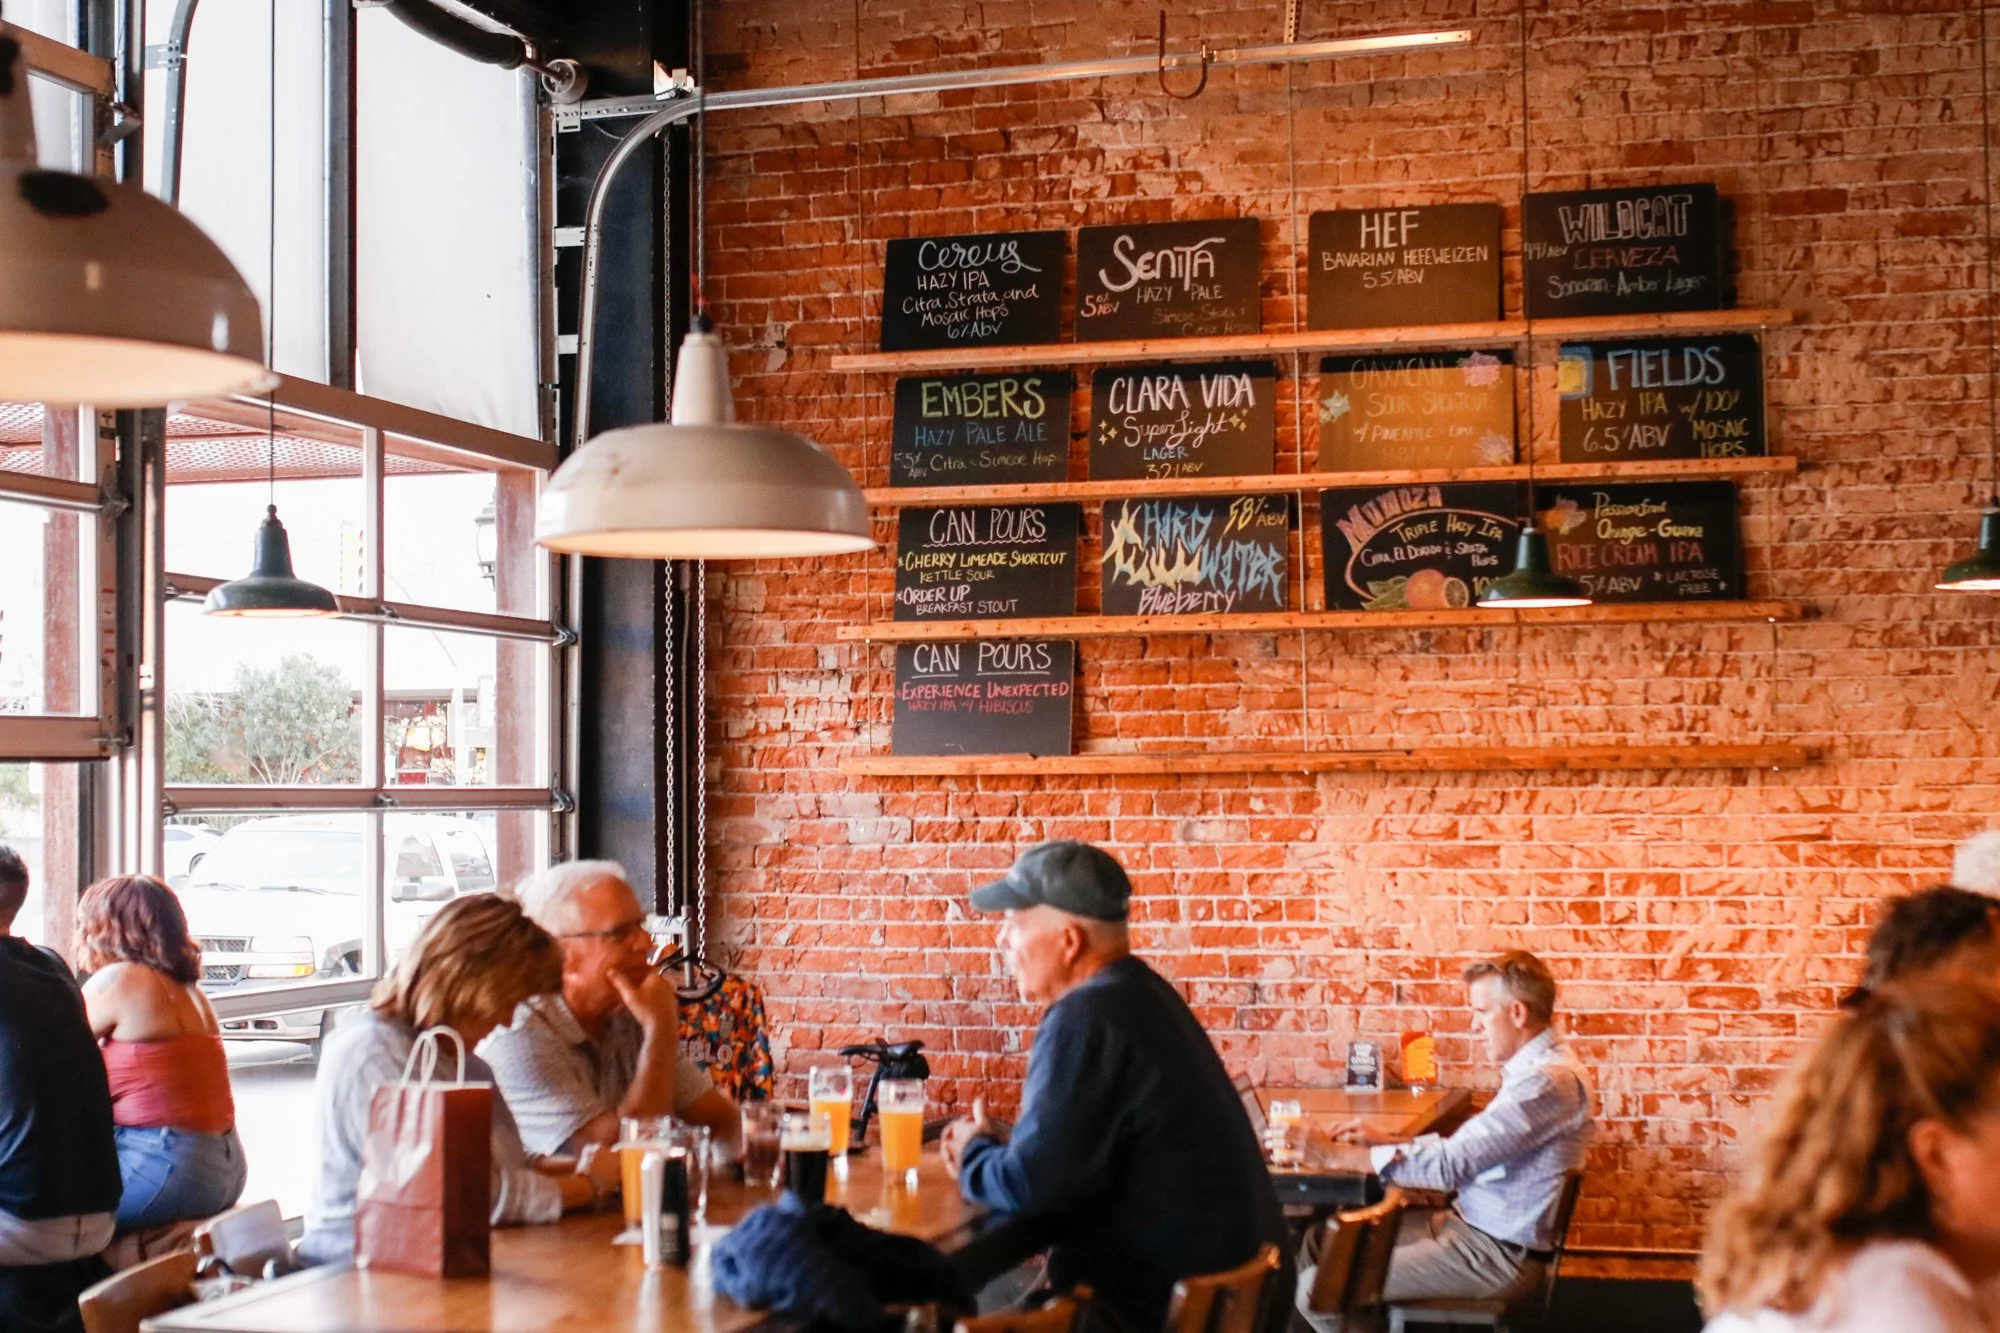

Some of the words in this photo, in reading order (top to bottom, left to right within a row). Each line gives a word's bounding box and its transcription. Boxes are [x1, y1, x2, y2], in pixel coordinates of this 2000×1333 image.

[1360, 210, 1420, 250] HEF
[1322, 251, 1396, 271] BAVARIAN
[1403, 245, 1488, 266] HEFEWEIZEN
[1574, 246, 1680, 270] CERVEZA
[917, 270, 958, 291] HAZY
[963, 270, 990, 290] IPA
[1003, 283, 1040, 299] and
[1136, 286, 1173, 304] HAZY
[1191, 284, 1223, 301] PALE
[921, 308, 969, 327] Mosaic
[975, 303, 1009, 321] Hops
[1097, 301, 1120, 316] ABV
[1351, 357, 1444, 390] OAXACAN
[1607, 346, 1726, 391] FIELDS
[921, 378, 1046, 420] EMBERS
[1109, 374, 1191, 415] CLARA
[1200, 373, 1256, 409] VIDA
[1581, 396, 1628, 422] HAZY
[1639, 391, 1669, 416] IPA
[914, 426, 956, 449] HAZY
[965, 421, 1007, 446] PALE
[1014, 420, 1048, 442] ALE
[1692, 418, 1750, 440] MOSAIC
[1143, 446, 1189, 461] LAGER
[1701, 441, 1748, 458] HOPS
[930, 453, 968, 472] Citra
[930, 509, 976, 544] CAN
[990, 508, 1046, 541] POURS
[1143, 500, 1214, 556] HARD
[1389, 519, 1439, 544] TRIPLE
[1446, 513, 1477, 538] HAZY
[1477, 517, 1503, 542] IPA
[905, 551, 956, 571] CHERRY
[960, 552, 1008, 568] LIMEADE
[1009, 550, 1067, 568] SHORTCUT
[1472, 554, 1499, 568] HOPS
[1556, 542, 1597, 572] RICE
[1600, 541, 1658, 566] CREAM
[1670, 540, 1705, 564] IPA
[919, 569, 963, 585] KETTLE
[967, 569, 995, 582] SOUR
[1200, 537, 1285, 608] WATER
[1667, 569, 1720, 584] LACTOSE
[903, 585, 946, 605] ORDER
[949, 584, 971, 602] UP
[1137, 581, 1236, 616] Blueberry
[1679, 583, 1711, 596] FREE
[916, 601, 973, 616] BREAKFAST
[977, 599, 1018, 614] STOUT
[913, 643, 960, 674] CAN
[977, 642, 1052, 672] POURS
[902, 681, 981, 701] EXPERIENCE
[987, 681, 1070, 699] UNEXPECTED
[908, 700, 937, 713] HAZY
[939, 701, 954, 713] IPA
[979, 700, 1034, 715] HIBISCUS
